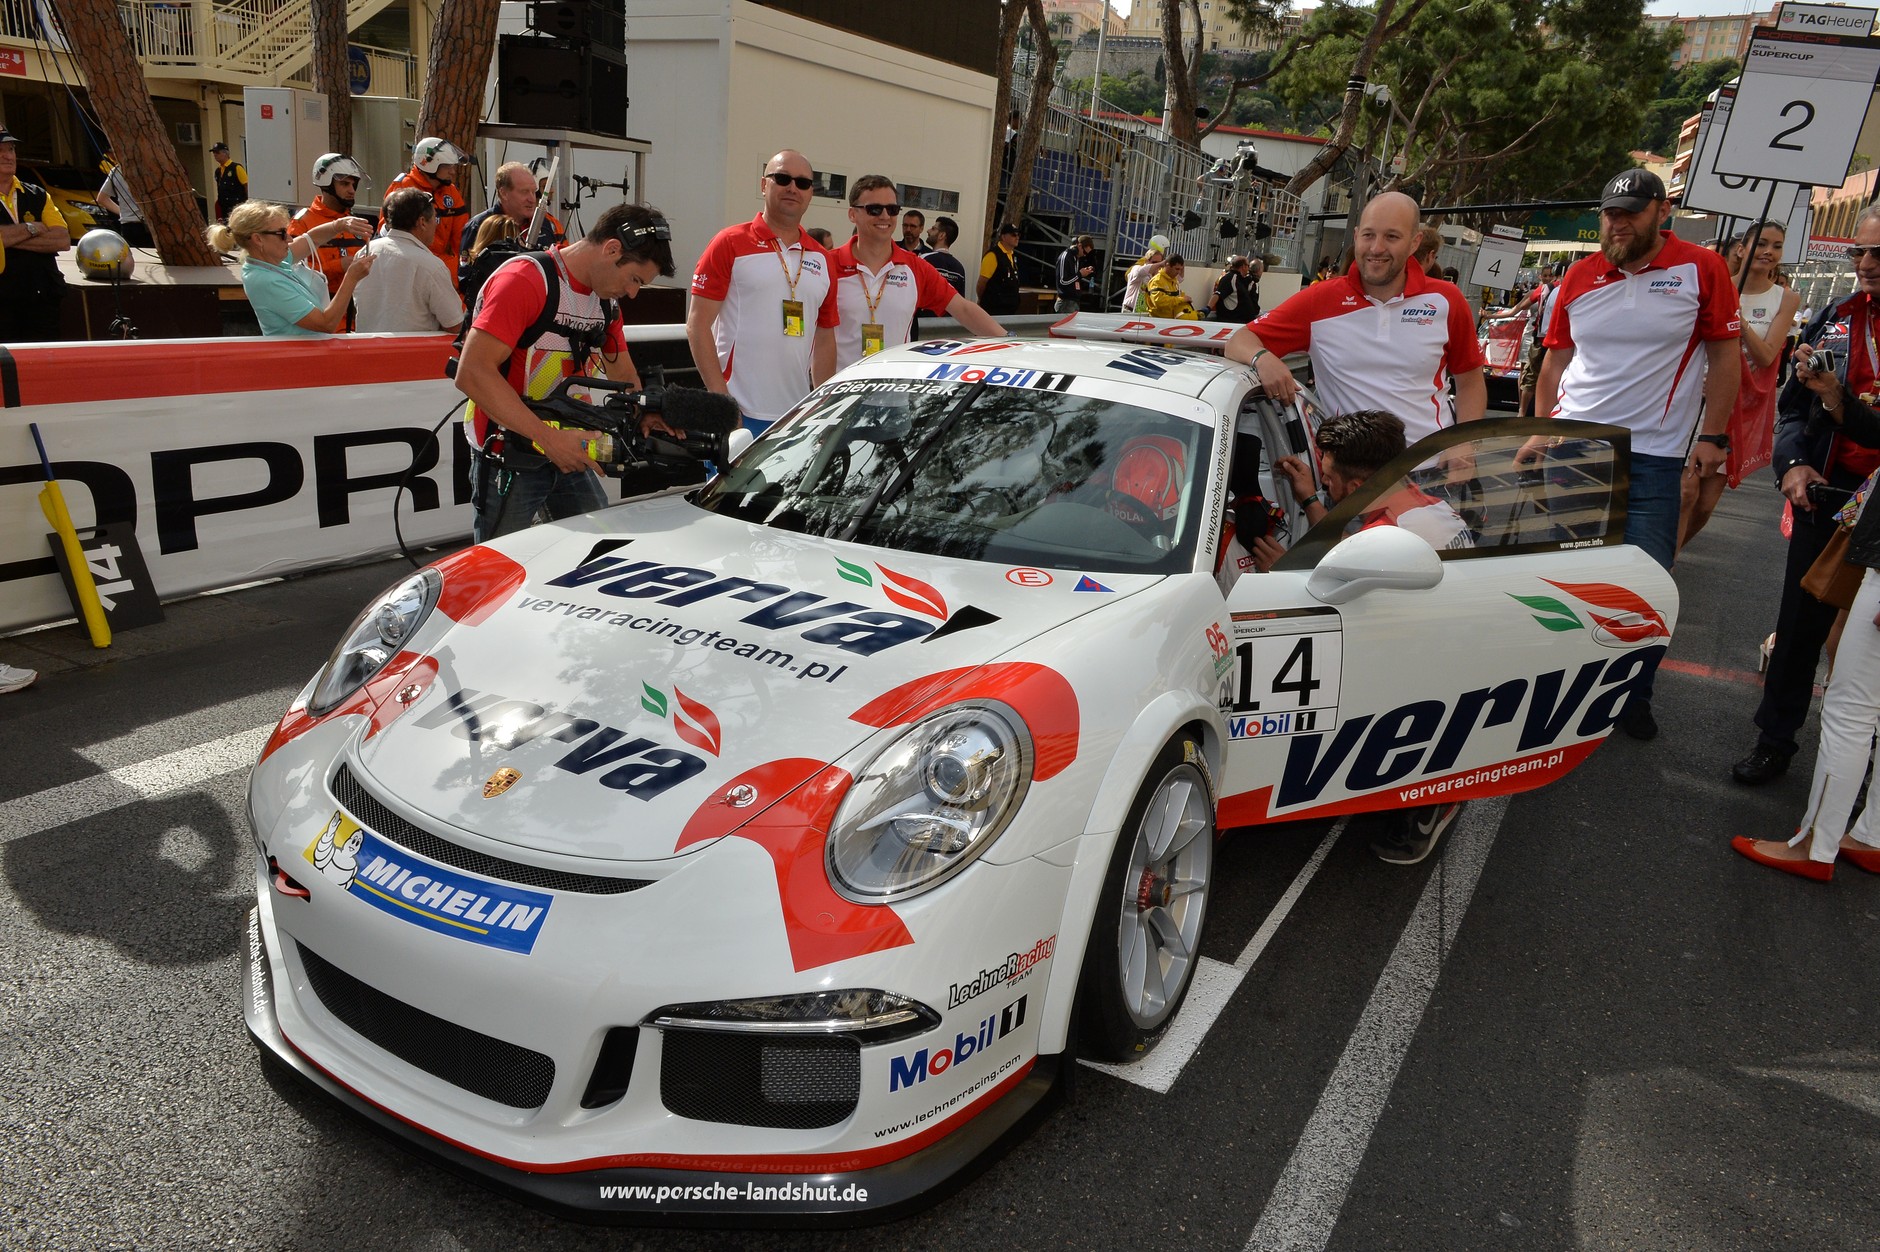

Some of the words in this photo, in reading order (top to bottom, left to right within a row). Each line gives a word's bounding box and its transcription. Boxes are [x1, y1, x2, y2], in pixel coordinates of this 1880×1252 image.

[1757, 30, 1841, 44] PORSCHE
[1799, 13, 1870, 29] TAGHeuer
[1751, 49, 1814, 61] SUPERCUP
[1768, 100, 1816, 151] 2
[1487, 258, 1501, 278] 4
[1650, 280, 1682, 288] verva
[1402, 307, 1437, 317] verva
[926, 364, 1037, 387] Mobil
[769, 395, 861, 439] 14
[1205, 414, 1232, 556] www.porsche.com/supercup
[1560, 539, 1604, 549] www.pmsc.info
[544, 556, 936, 657] verva
[517, 597, 849, 684] vervaracingteam.pl
[1232, 636, 1320, 713] 14
[411, 687, 708, 802] verva
[1229, 714, 1290, 738] Mobil
[1275, 644, 1669, 809] verva
[1400, 750, 1565, 803] vervaracingteam.pl
[359, 855, 544, 932] MICHELIN
[246, 904, 269, 1016] www.porsche-landshut.de
[1005, 967, 1033, 990] TEAM
[889, 1014, 996, 1093] Mobil
[874, 1054, 1022, 1139] www.lechnerracing.com
[599, 1181, 868, 1204] www.porsche-landshut.de
